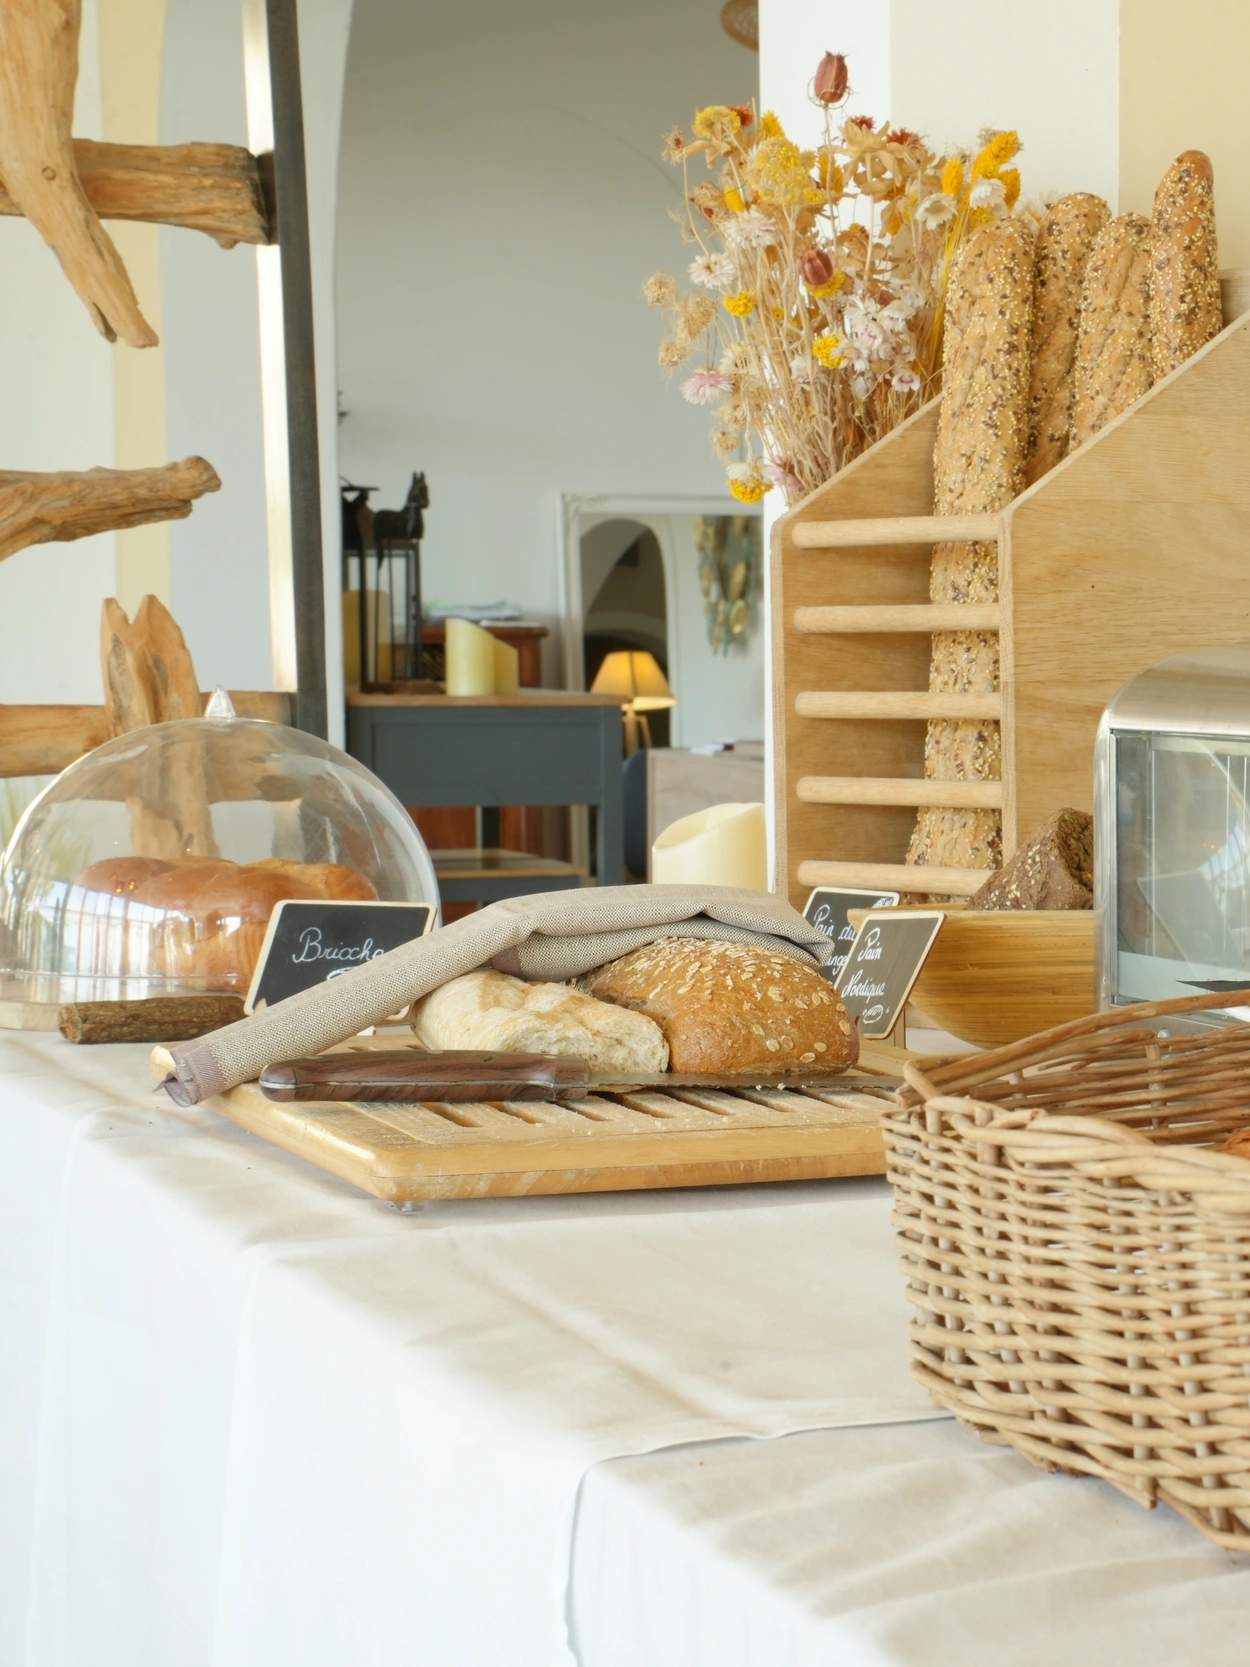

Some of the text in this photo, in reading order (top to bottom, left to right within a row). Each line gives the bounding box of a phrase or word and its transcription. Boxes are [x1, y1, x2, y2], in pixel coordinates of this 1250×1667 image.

[815, 904, 833, 936] Pain
[857, 928, 882, 962] Pain
[841, 969, 886, 1003] Nordique
